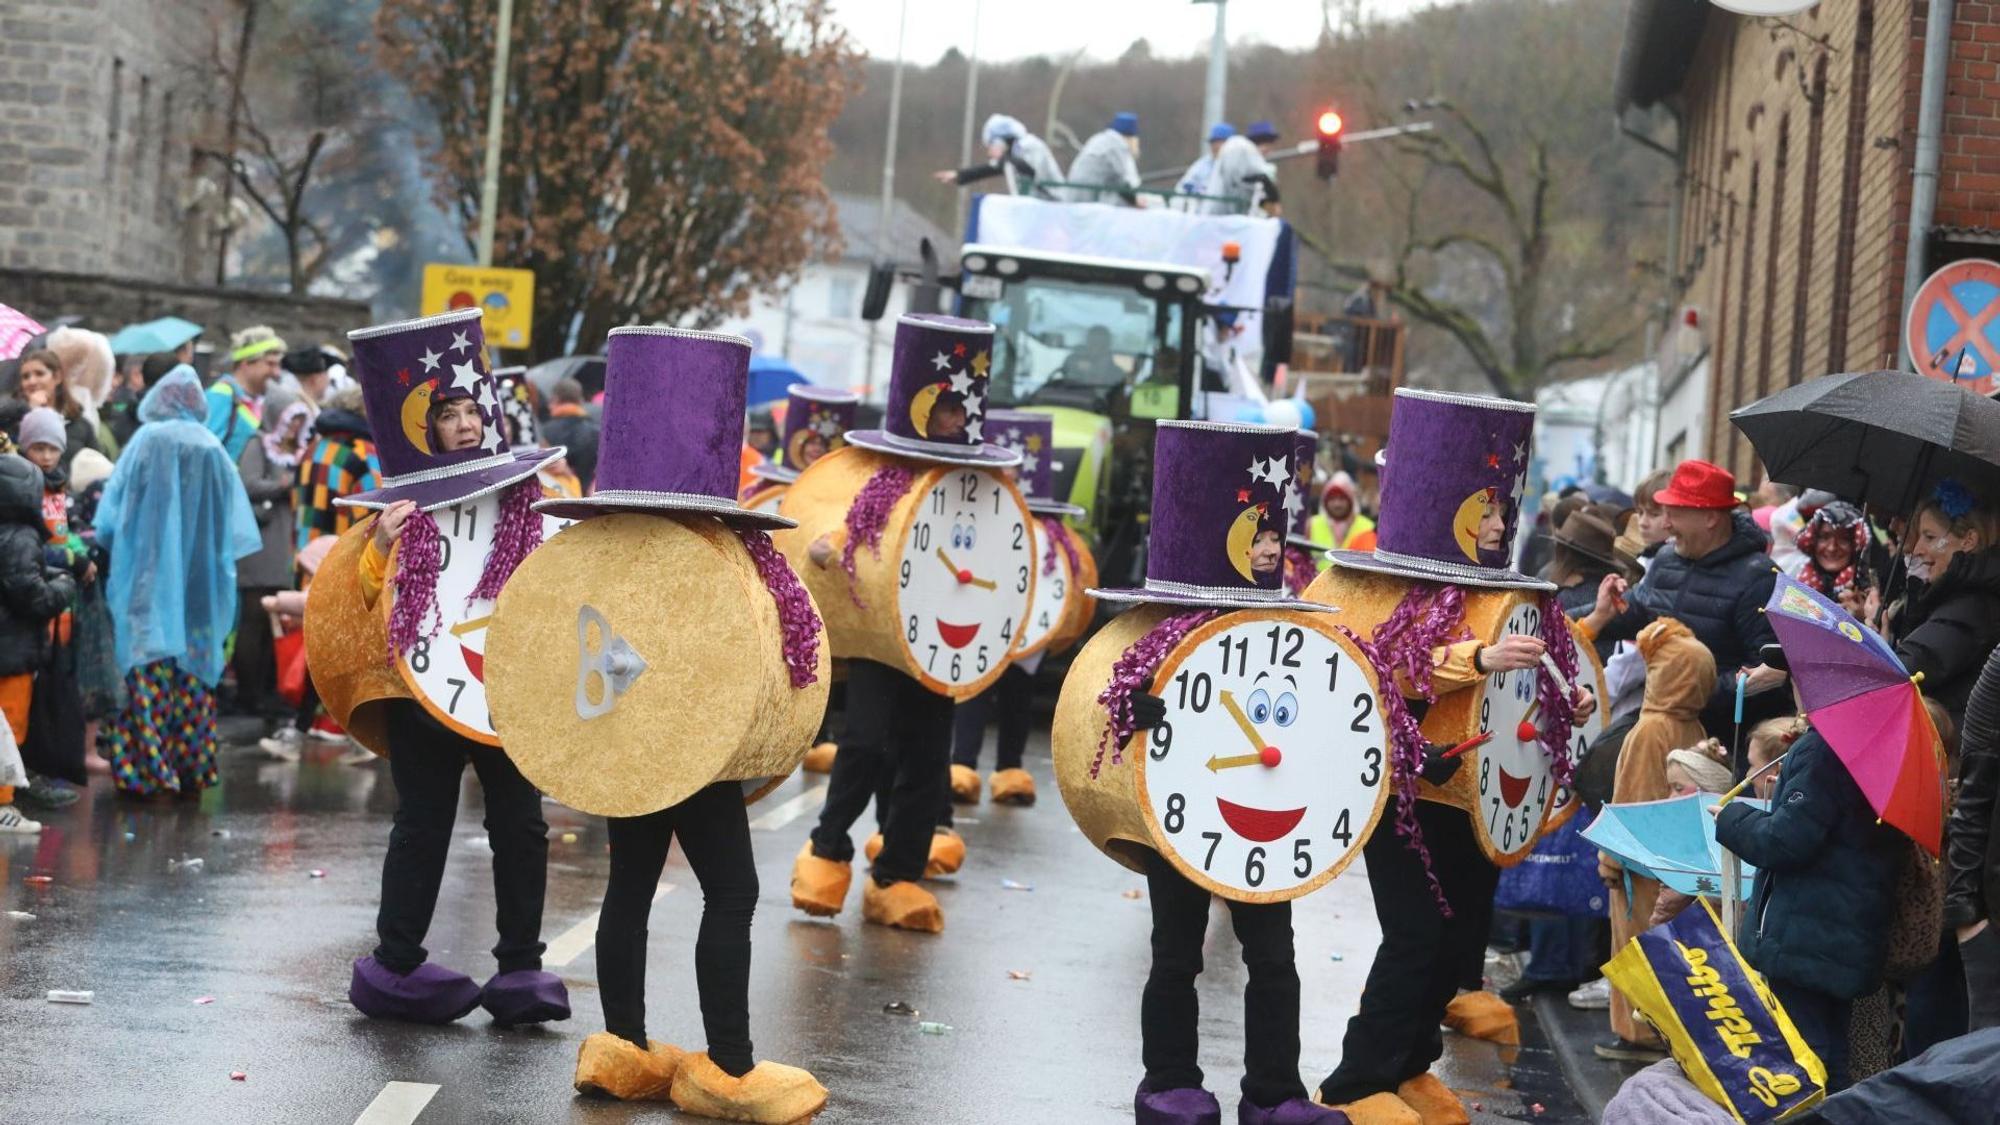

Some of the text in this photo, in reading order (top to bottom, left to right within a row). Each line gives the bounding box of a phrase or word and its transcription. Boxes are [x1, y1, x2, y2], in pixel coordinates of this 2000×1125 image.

[444, 268, 515, 292] Gas weg
[932, 487, 946, 516] 11
[960, 473, 978, 503] 12
[993, 487, 1001, 515] 1
[913, 521, 930, 552] 10
[1012, 523, 1023, 551] 2
[901, 559, 911, 588] 9
[1017, 565, 1028, 594] 3
[1052, 579, 1065, 601] 3
[908, 614, 918, 644] 8
[1001, 617, 1011, 645] 4
[1038, 610, 1049, 630] 4
[1523, 606, 1538, 637] 12
[411, 636, 430, 673] 8
[928, 645, 938, 672] 7
[977, 646, 988, 674] 5
[1219, 635, 1249, 677] 11
[1267, 625, 1305, 667] 12
[951, 653, 961, 682] 6
[1325, 652, 1339, 692] 1
[447, 677, 466, 714] 7
[1175, 669, 1212, 714] 10
[1350, 693, 1373, 733] 2
[1480, 697, 1490, 734] 9
[1150, 720, 1173, 762] 9
[1360, 747, 1382, 787] 3
[1480, 757, 1490, 796] 8
[1537, 775, 1547, 812] 4
[1164, 793, 1186, 834] 8
[1332, 808, 1353, 848] 4
[1489, 797, 1500, 835] 7
[1503, 811, 1514, 851] 6
[1519, 805, 1531, 843] 5
[1202, 831, 1222, 871] 7
[1245, 847, 1266, 887] 6
[1293, 839, 1313, 878] 5
[1673, 939, 1763, 1060] Tchibo
